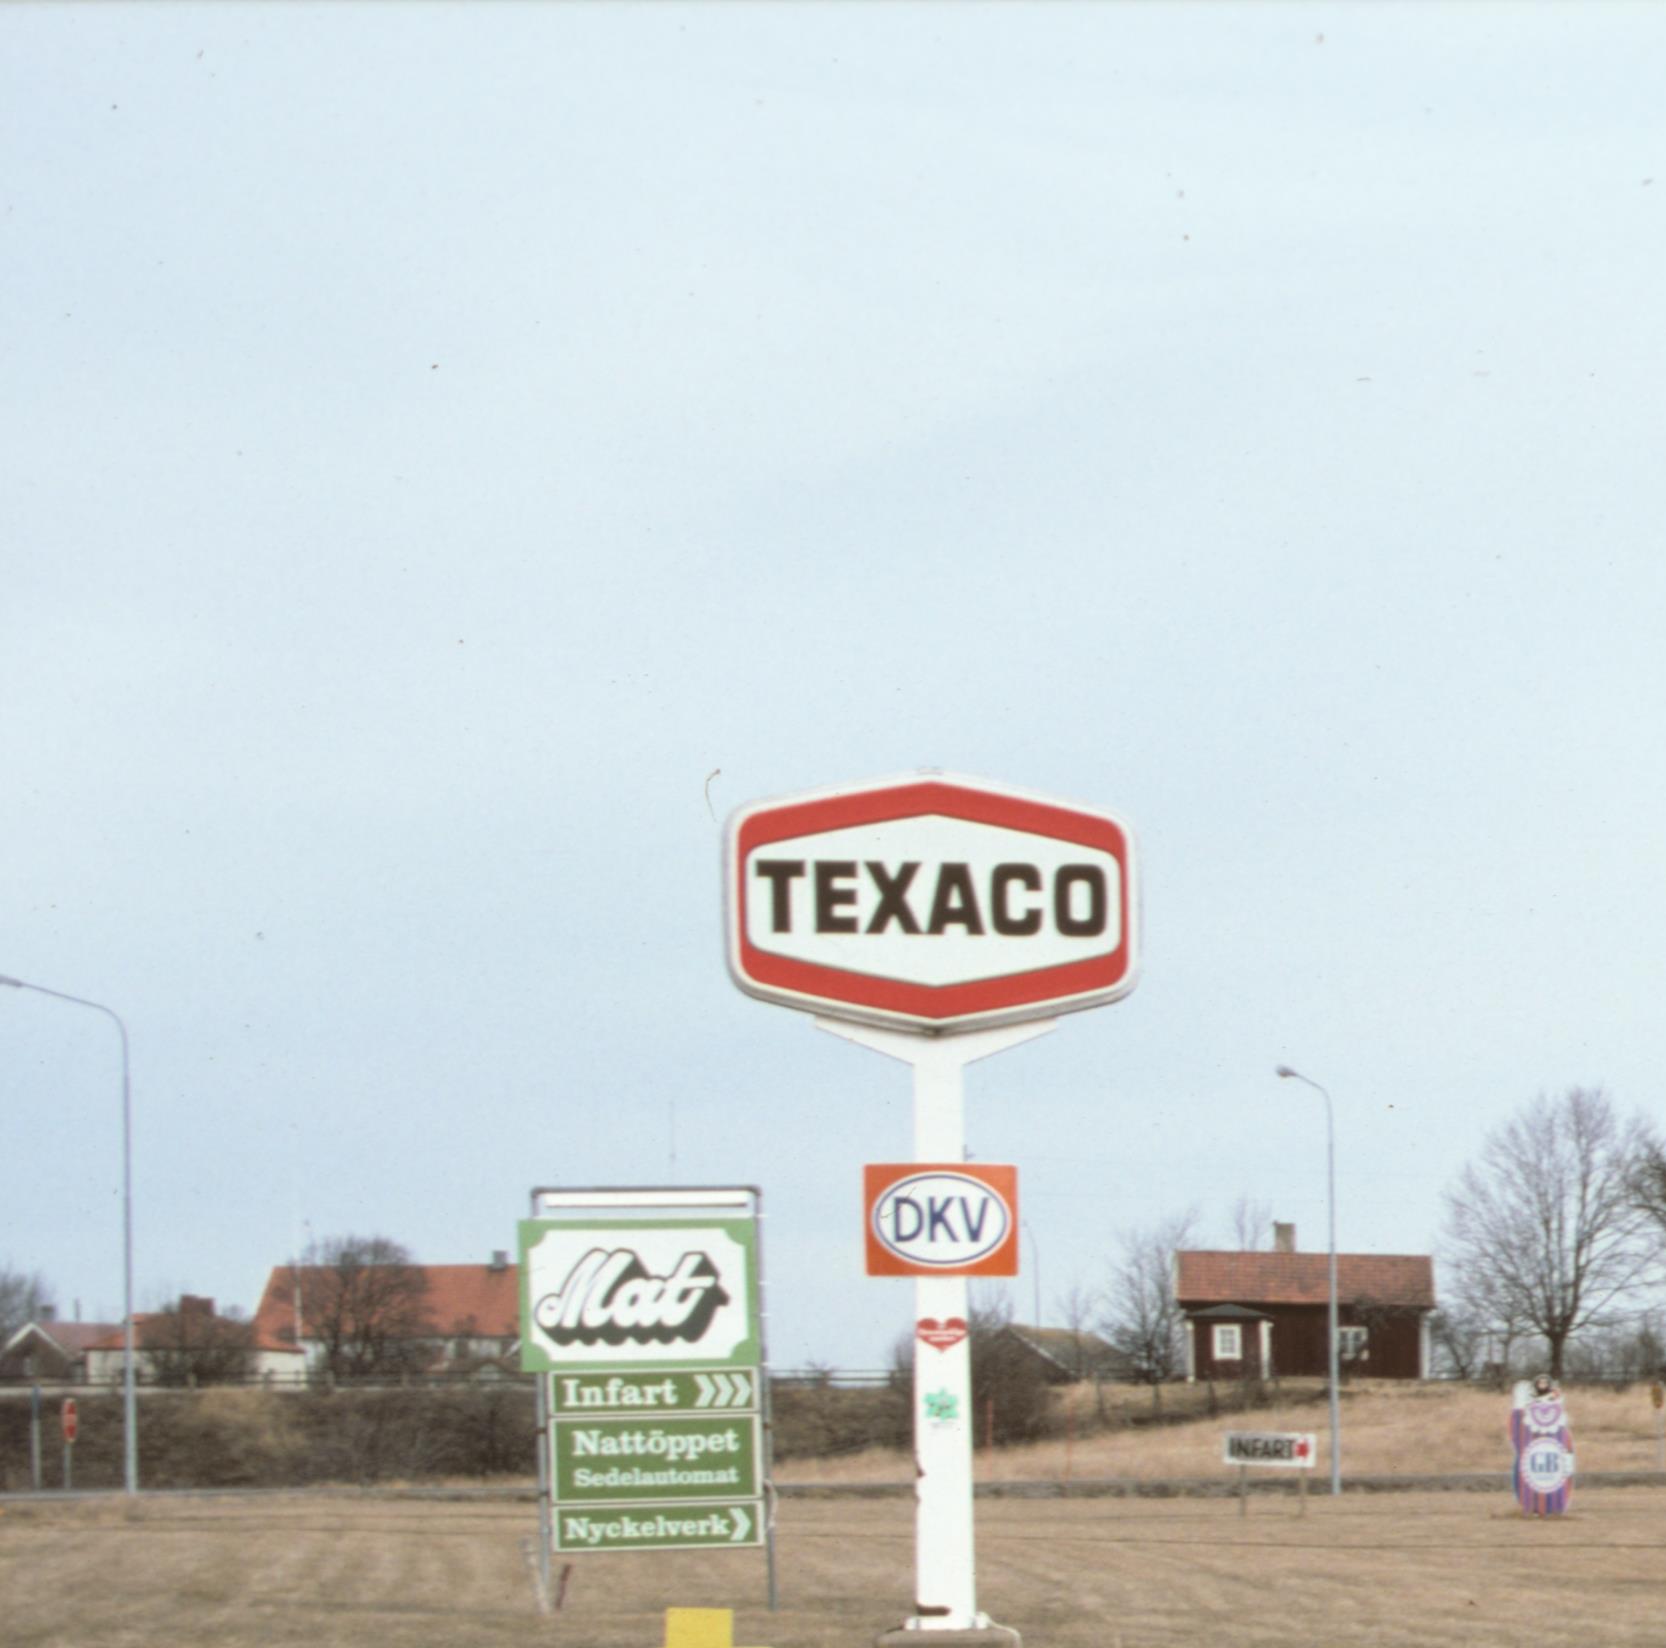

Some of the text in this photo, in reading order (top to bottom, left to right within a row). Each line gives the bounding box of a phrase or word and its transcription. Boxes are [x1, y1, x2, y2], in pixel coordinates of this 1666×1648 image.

[755, 858, 1108, 938] TEXACO
[892, 1196, 991, 1243] DKV
[534, 1247, 724, 1340] Mat
[563, 1376, 678, 1408] Infart
[571, 1427, 740, 1462] Nattöppet
[1228, 1437, 1296, 1462] INFART
[573, 1465, 740, 1488] Sedelautomat
[1529, 1451, 1560, 1474] GB
[563, 1514, 731, 1543] Nyckelverk
